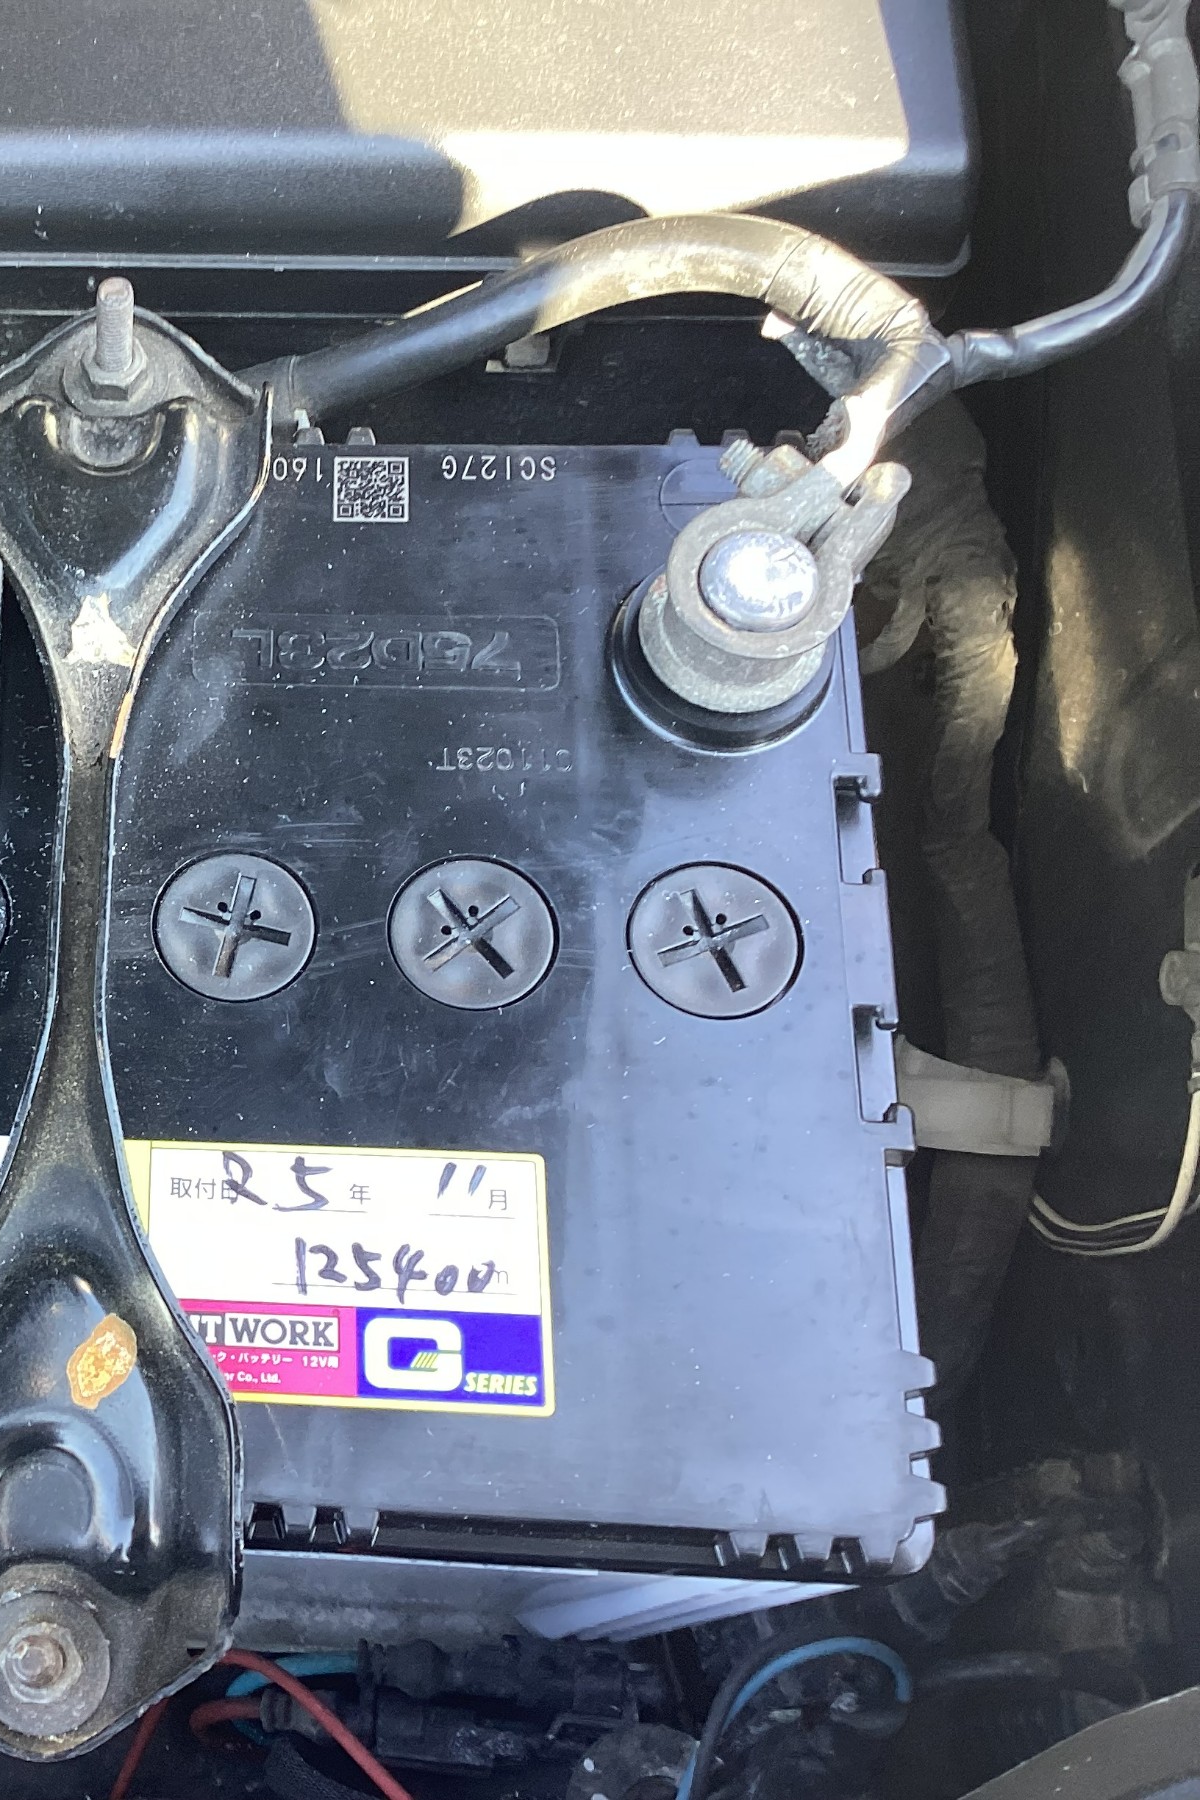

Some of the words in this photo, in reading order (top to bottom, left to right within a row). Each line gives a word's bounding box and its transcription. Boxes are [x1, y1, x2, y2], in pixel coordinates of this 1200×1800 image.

[231, 627, 522, 682] 75D23L
[272, 1155, 334, 1212] 5
[349, 1183, 371, 1205] 年
[488, 1189, 508, 1211] 月
[294, 1237, 496, 1304] 125400
[228, 1317, 335, 1348] WORK
[260, 1371, 282, 1384] Ltd.
[464, 1371, 538, 1397] SERIES
